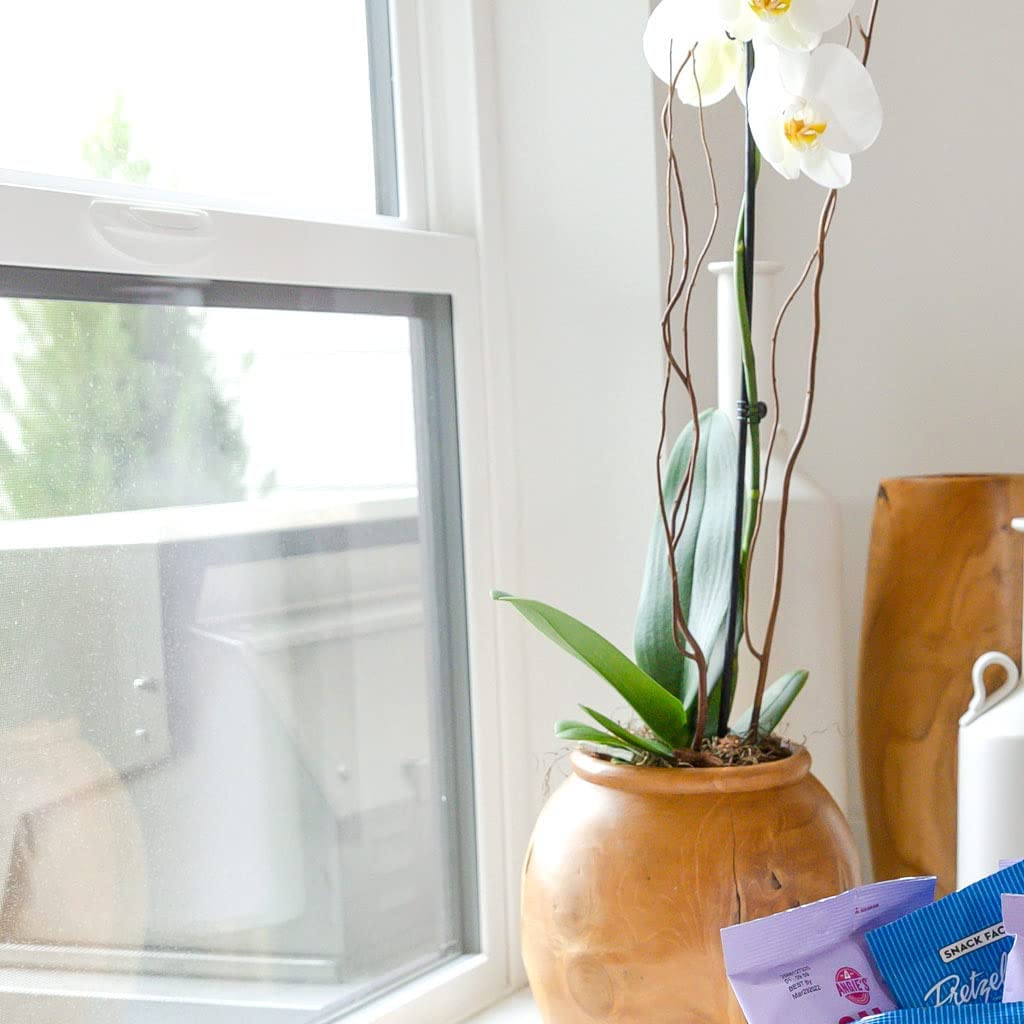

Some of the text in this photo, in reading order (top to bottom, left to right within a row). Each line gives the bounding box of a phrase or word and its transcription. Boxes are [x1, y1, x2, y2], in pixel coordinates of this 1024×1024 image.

[944, 936, 983, 959] SNACK
[835, 978, 870, 997] ANGIE'S
[924, 952, 1007, 1007] Pretzel
